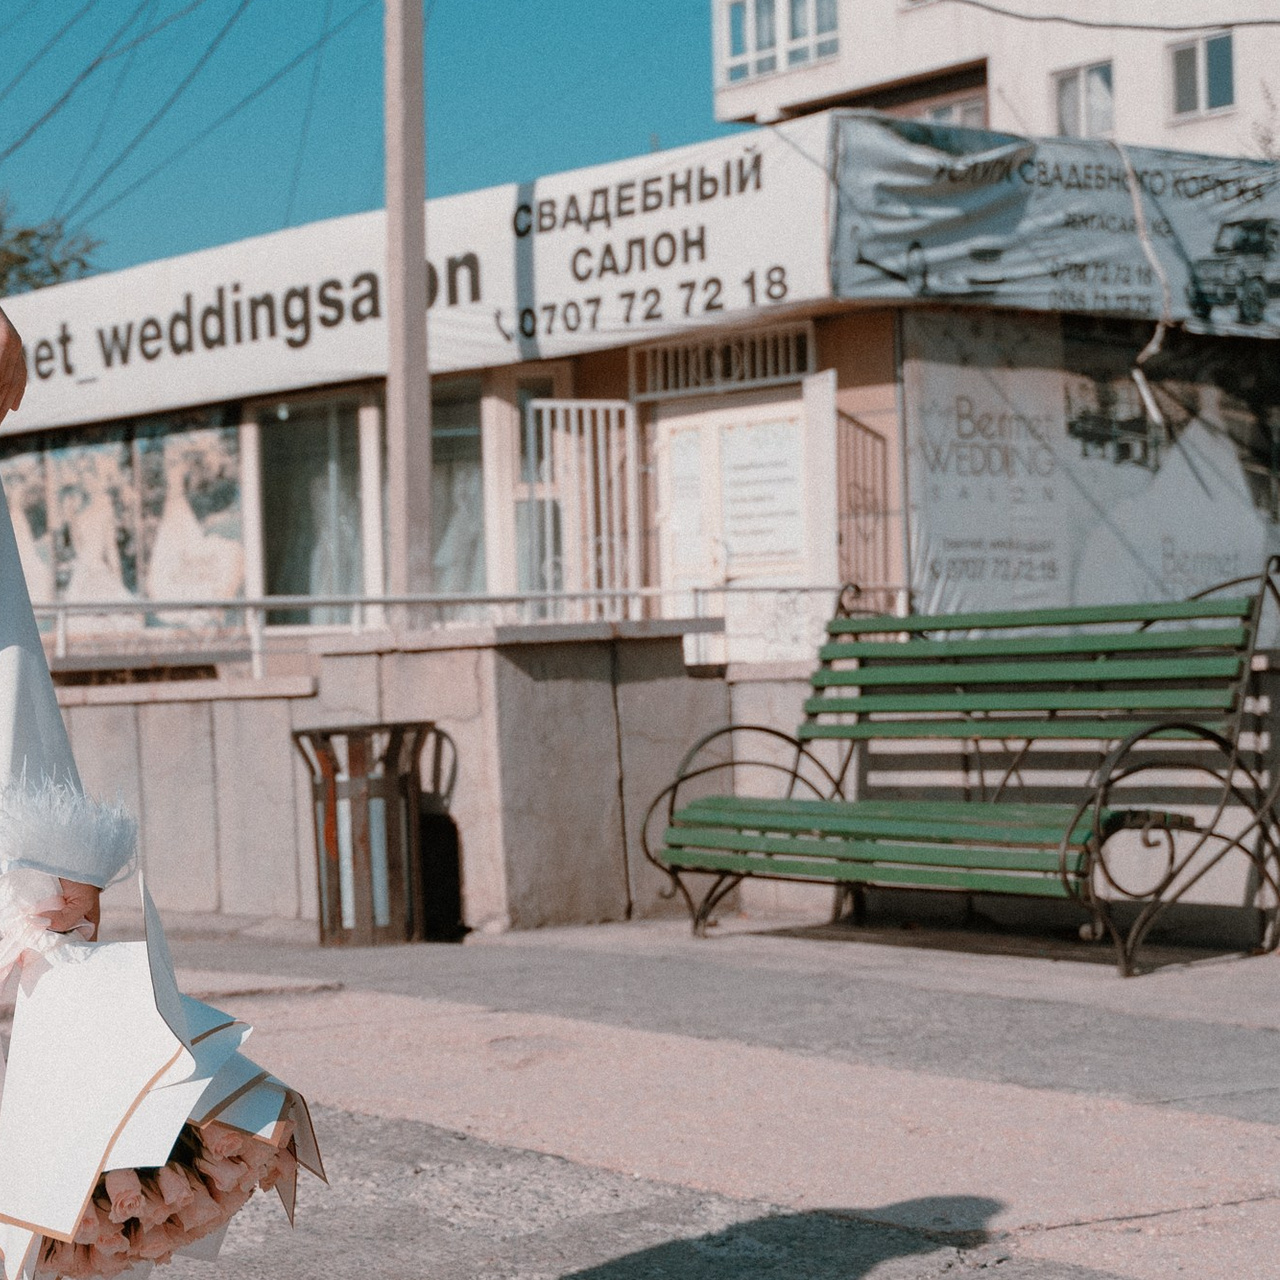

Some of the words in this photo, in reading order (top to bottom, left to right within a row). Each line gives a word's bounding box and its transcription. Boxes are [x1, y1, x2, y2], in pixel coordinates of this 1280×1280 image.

[512, 145, 763, 238] СВАДЕБНЫЙ
[571, 225, 707, 282] САЛОН
[22, 251, 481, 384] et_weddingsan
[520, 298, 601, 338] 0707
[621, 288, 662, 323] 72
[680, 278, 723, 316] 72
[742, 266, 788, 307] 18
